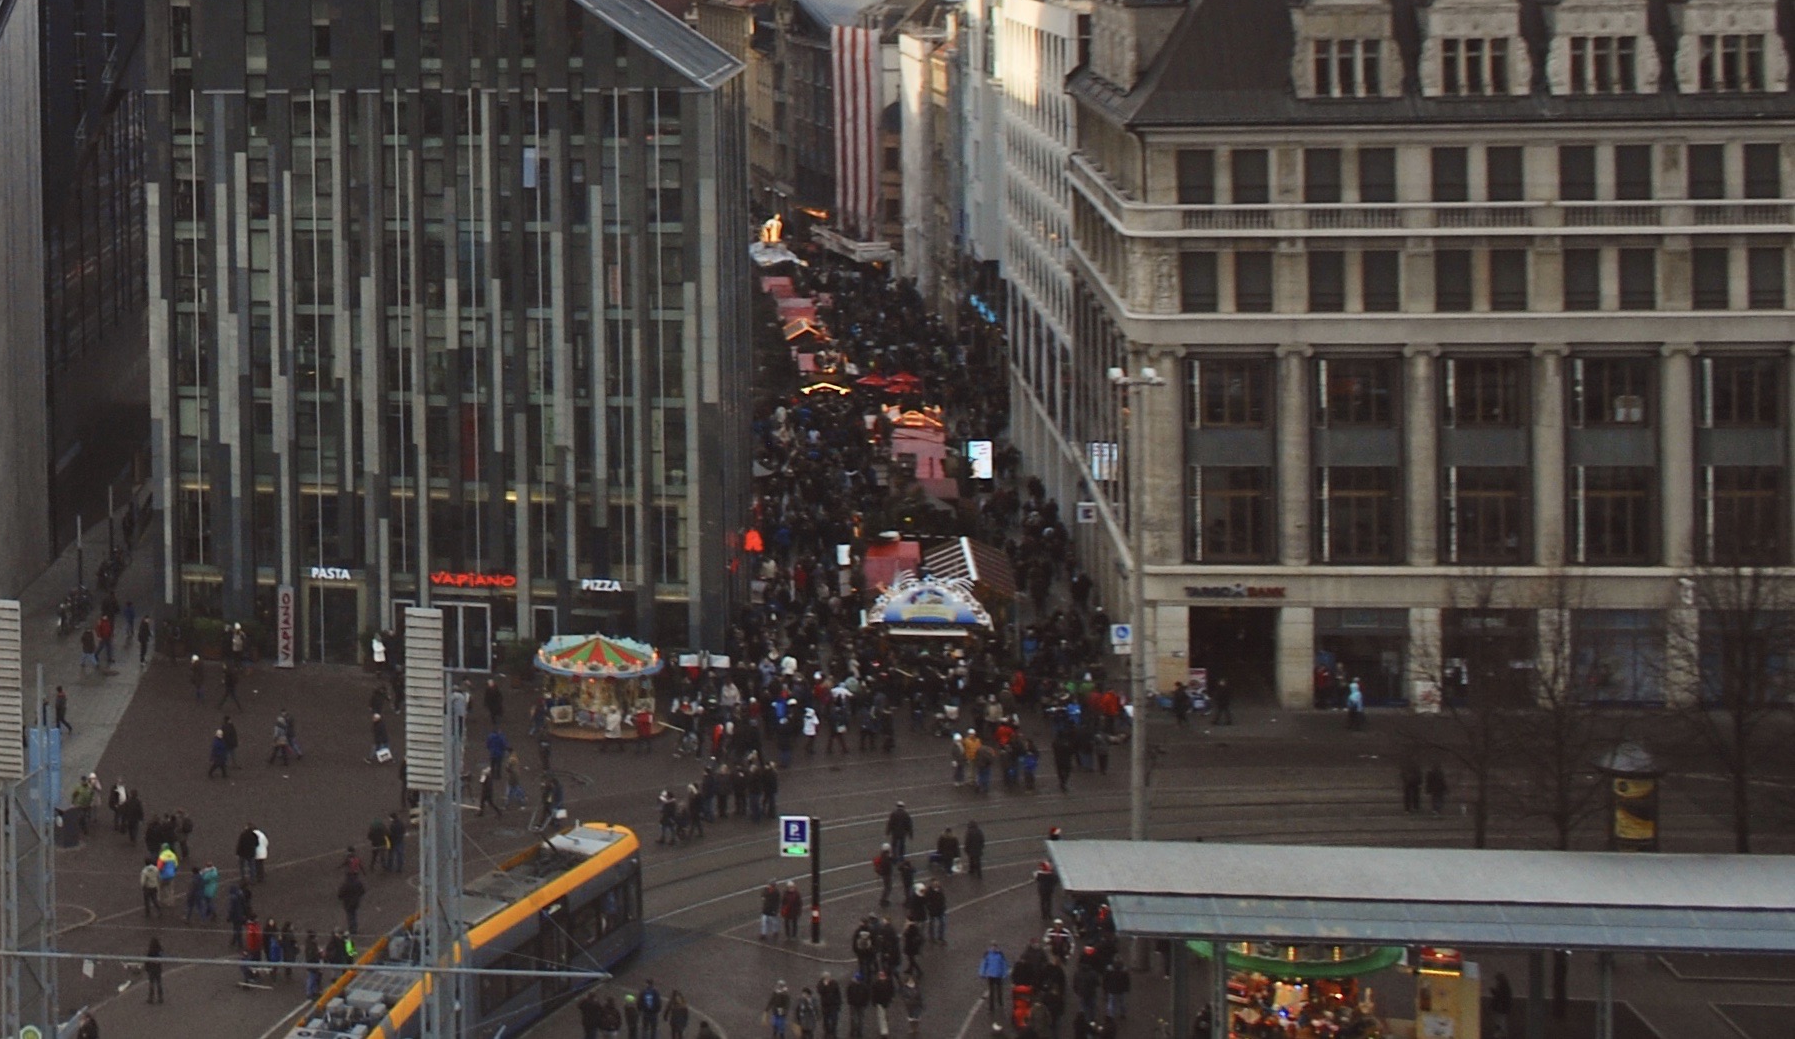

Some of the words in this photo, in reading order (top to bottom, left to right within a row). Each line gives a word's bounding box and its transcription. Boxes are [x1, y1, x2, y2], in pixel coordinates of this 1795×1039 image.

[311, 566, 351, 581] PASTA
[581, 578, 622, 592] PIZZA
[789, 822, 800, 836] P
